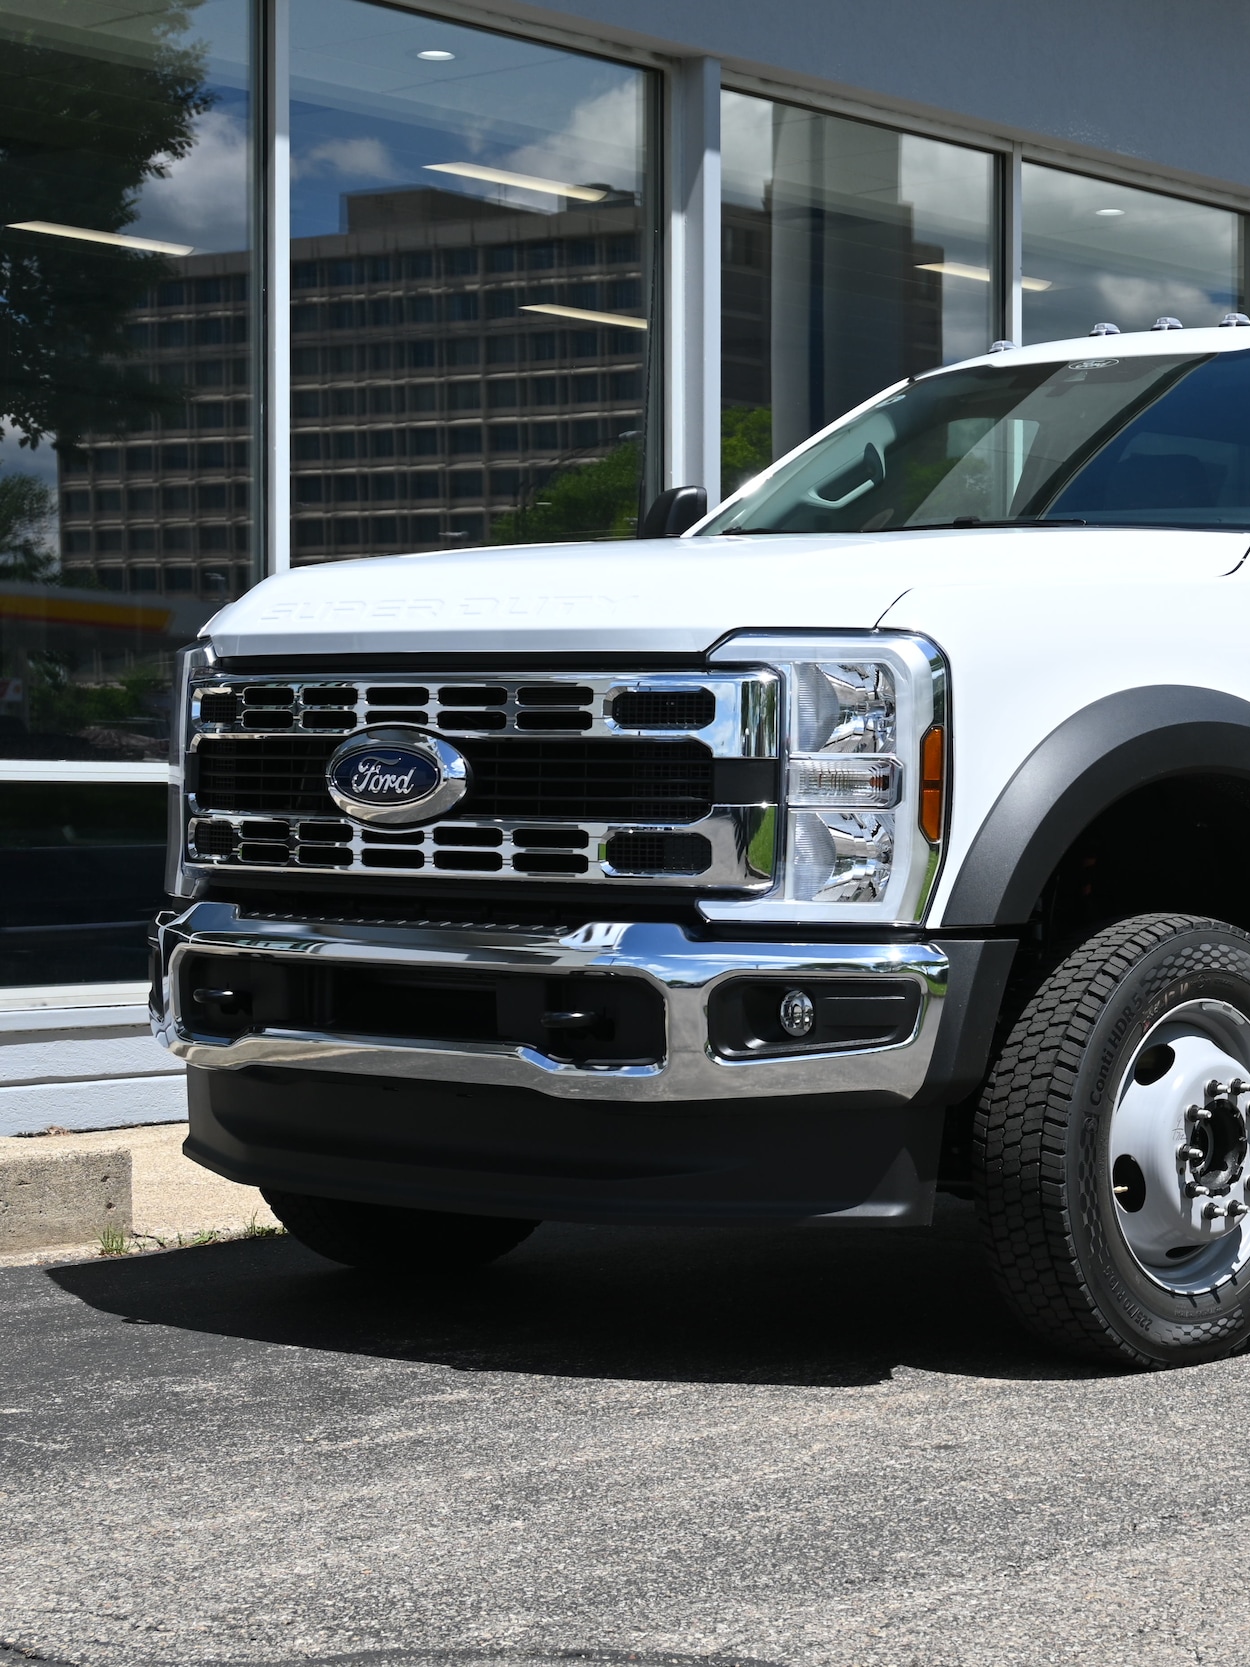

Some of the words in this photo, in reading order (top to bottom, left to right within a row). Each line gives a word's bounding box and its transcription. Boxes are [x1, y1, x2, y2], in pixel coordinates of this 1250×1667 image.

[259, 598, 446, 623] SUPER
[460, 595, 640, 617] DUTY
[352, 756, 416, 794] Ford
[1090, 1048, 1115, 1106] Conti
[1107, 1005, 1136, 1049] HDR
